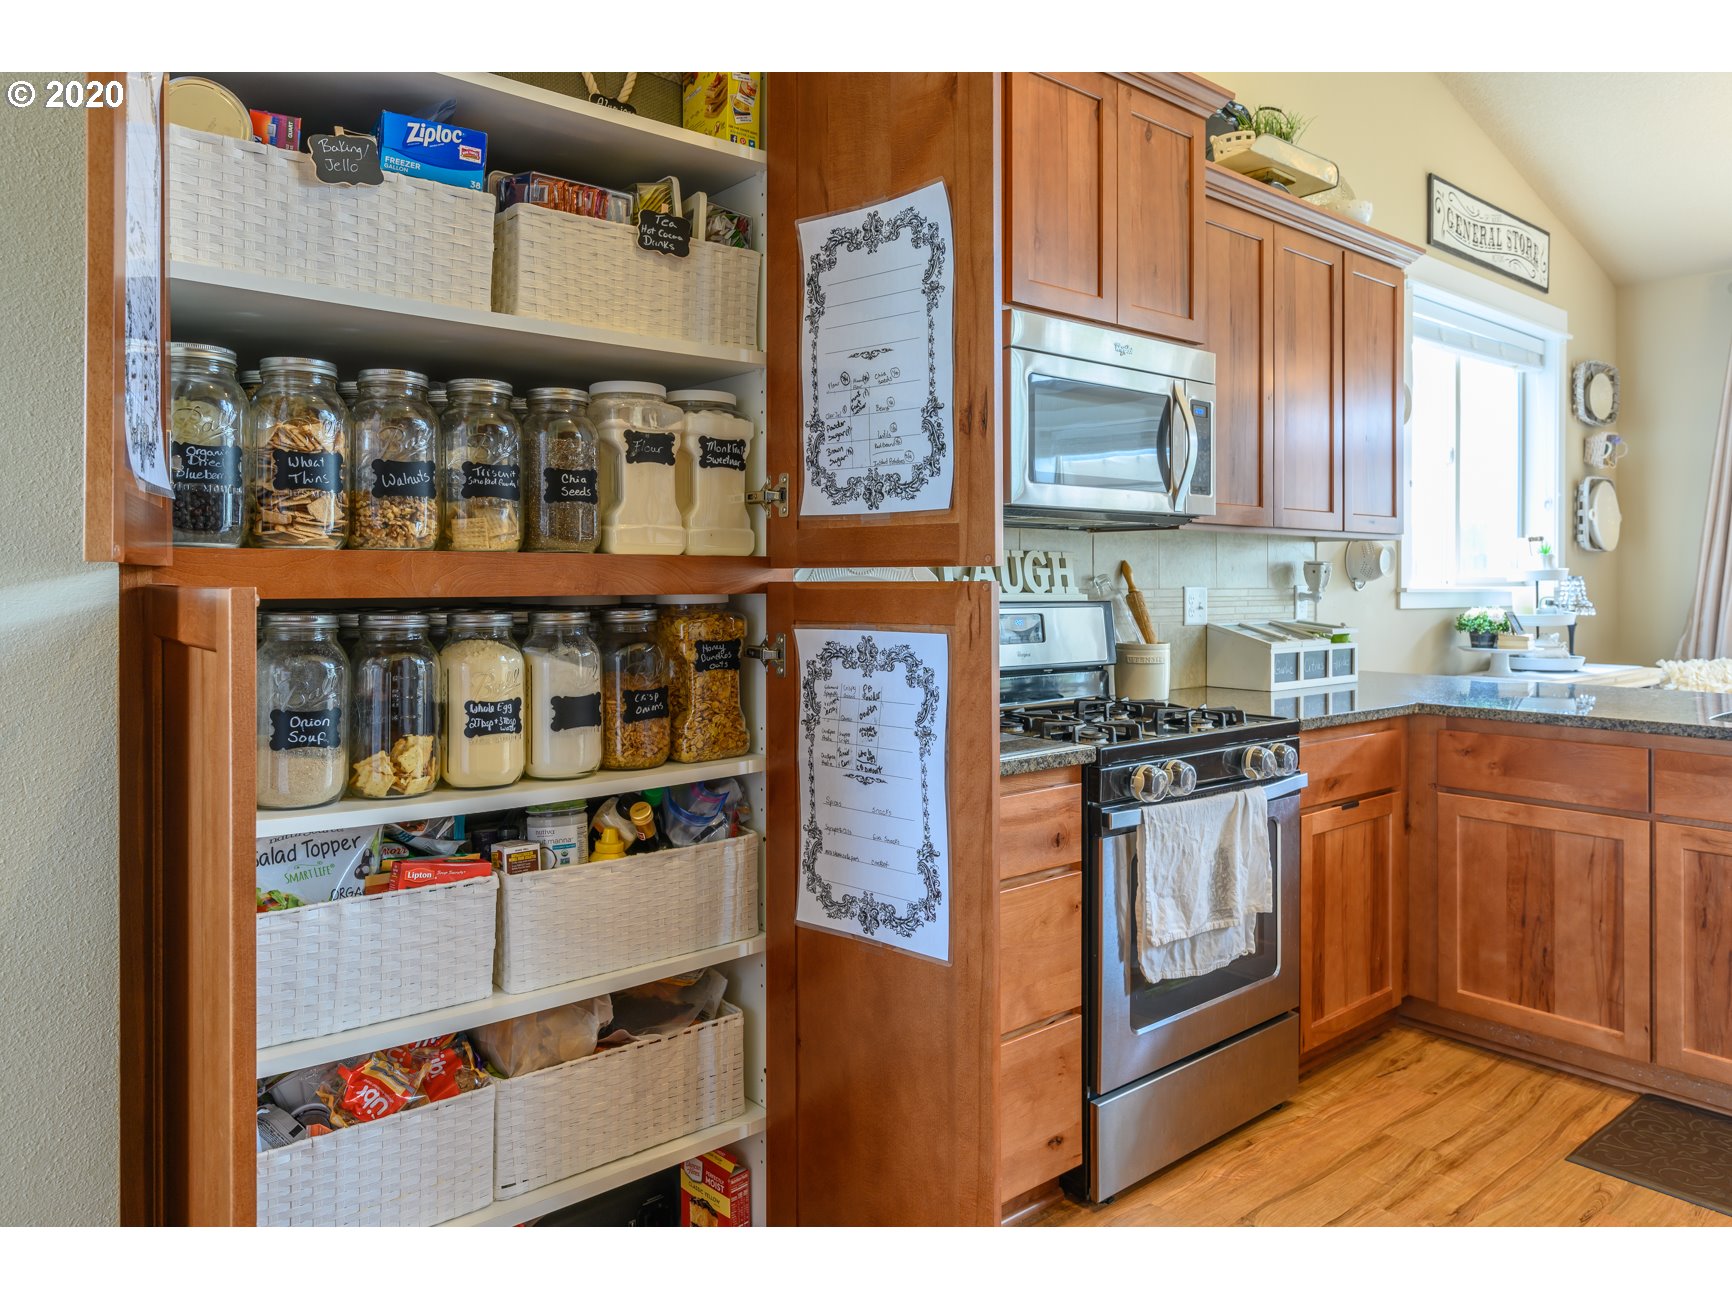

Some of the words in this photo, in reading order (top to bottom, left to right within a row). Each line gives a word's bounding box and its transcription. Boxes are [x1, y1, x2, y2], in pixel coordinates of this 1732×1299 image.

[406, 122, 463, 147] Ziploc
[324, 158, 359, 174] Jello
[383, 162, 409, 174] GALLON
[384, 155, 421, 170] FREEZER
[469, 180, 482, 190] 38
[656, 214, 677, 228] Tea
[641, 224, 656, 234] Hot
[658, 229, 684, 241] Cocoa
[1446, 206, 1503, 250] GENERAL
[1506, 229, 1540, 265] STORE
[643, 234, 676, 250] Drinks
[632, 440, 663, 456] Flour
[288, 456, 326, 469] Wheat
[288, 472, 331, 485] Thins
[381, 470, 432, 488] Walnuts
[561, 474, 588, 485] Chia
[561, 486, 592, 498] Seeds
[702, 643, 727, 655] Honey
[634, 692, 660, 703] Crisp
[470, 703, 495, 713] Whole
[497, 702, 513, 714] Egg
[289, 716, 331, 735] Onion
[287, 730, 329, 744] Soup
[547, 837, 572, 845] manna
[256, 843, 297, 868] alad
[301, 836, 362, 859] Topper
[407, 871, 432, 880] Lipton
[705, 1170, 725, 1184] PERFECTLY
[705, 1176, 725, 1194] MOIST
[688, 1181, 703, 1195] CLASSIC
[704, 1191, 720, 1205] YELLOW
